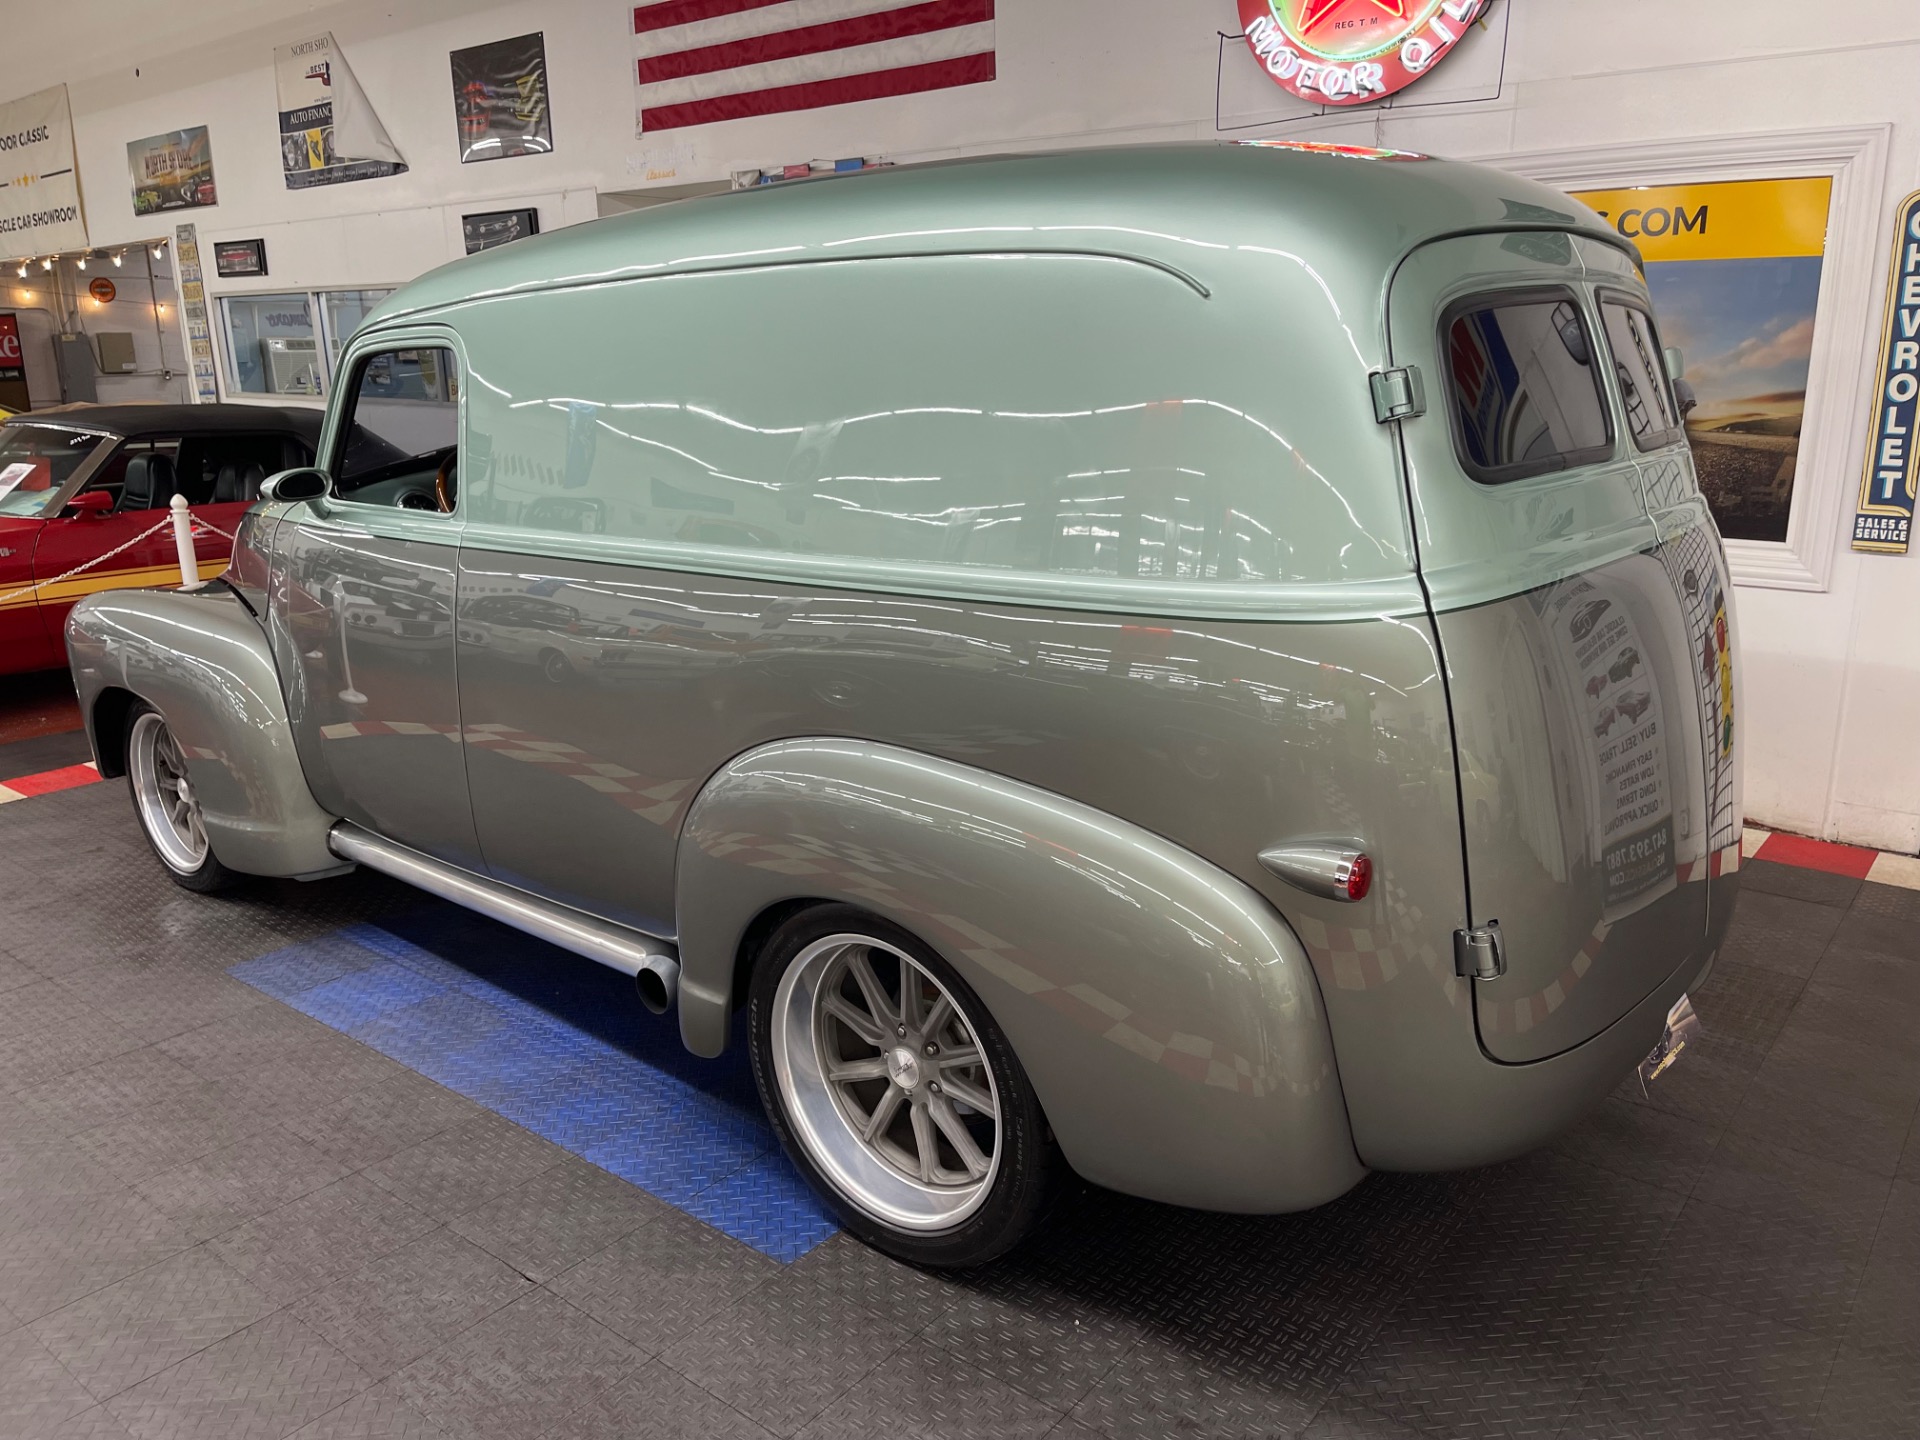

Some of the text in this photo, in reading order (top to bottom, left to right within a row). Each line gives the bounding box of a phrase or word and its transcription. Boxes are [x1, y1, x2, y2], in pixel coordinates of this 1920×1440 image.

[291, 38, 314, 57] NORTH
[1245, 15, 1387, 100] MOTOR
[309, 63, 326, 74] BEST
[290, 110, 308, 125] AUTO
[18, 125, 50, 147] CLASSIC
[17, 214, 32, 231] CAR
[32, 206, 78, 228] SHOWROOM
[1597, 205, 1709, 239] COM
[1857, 516, 1909, 531] SALES &
[1855, 528, 1907, 542] SERVICE
